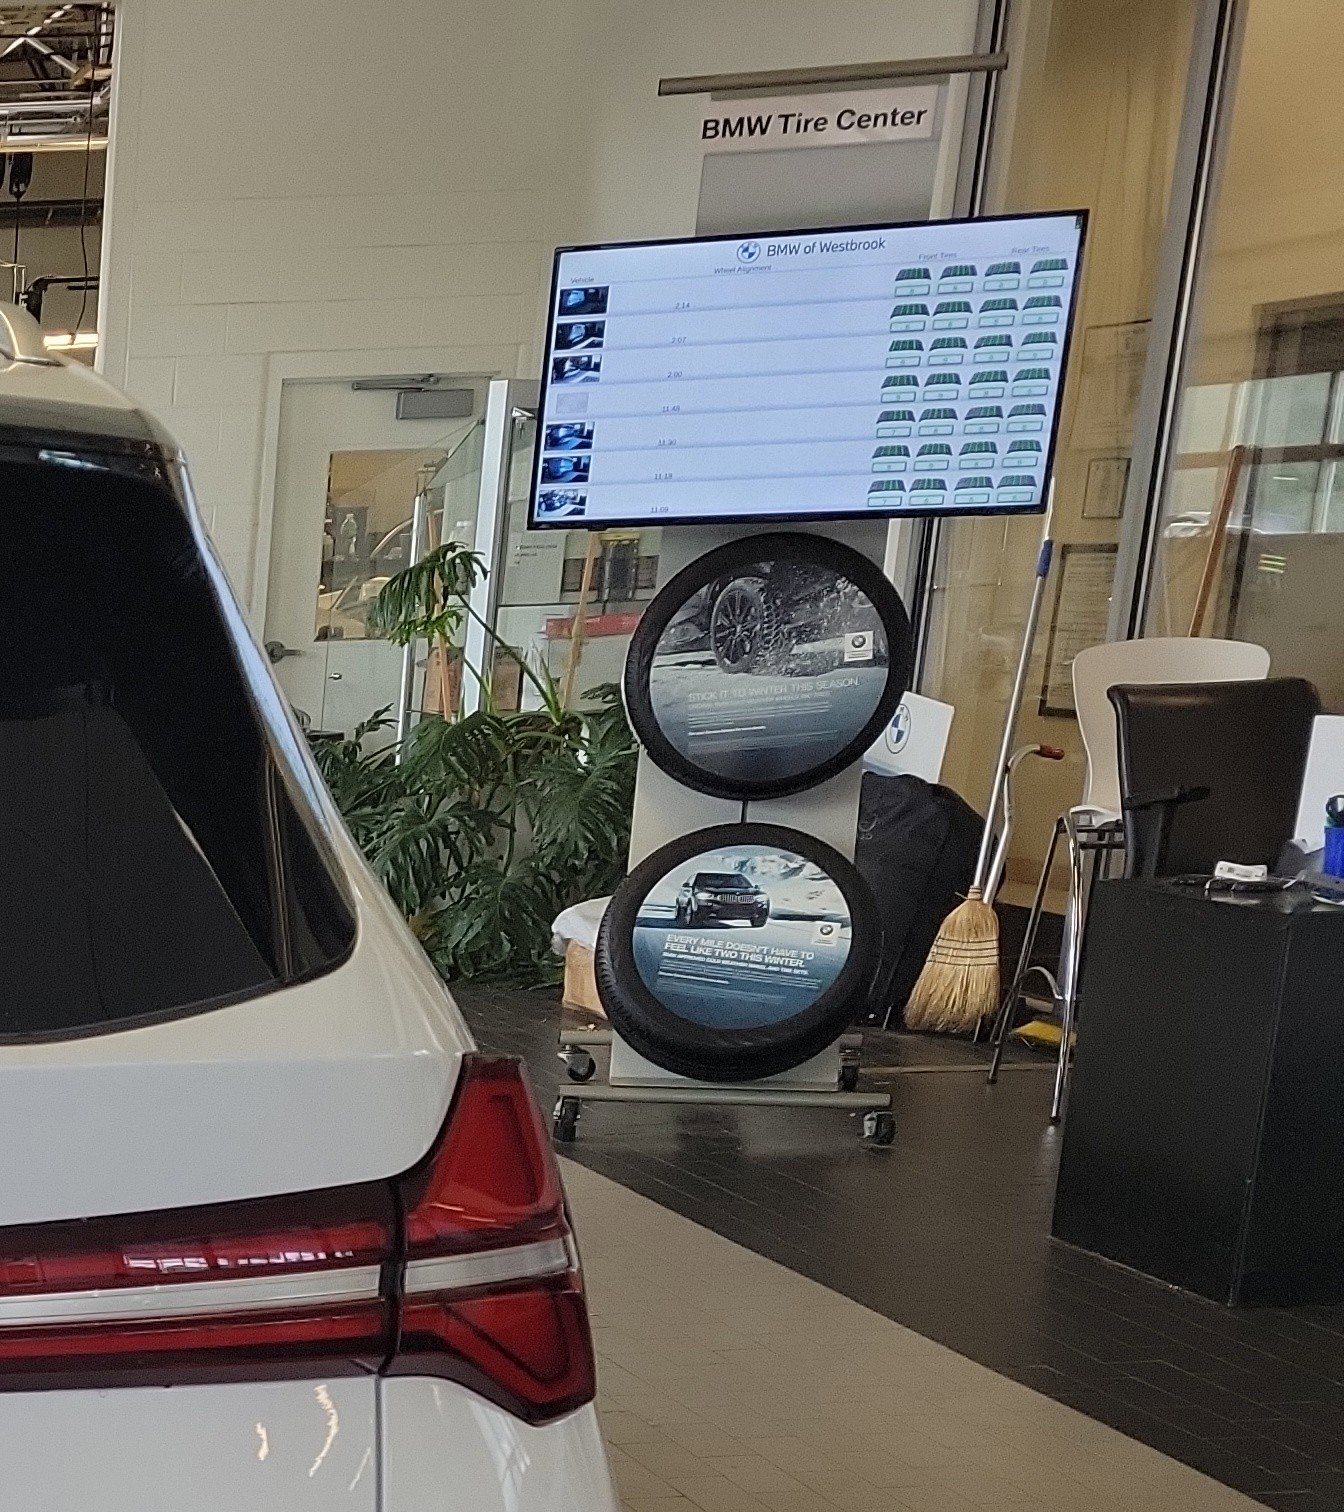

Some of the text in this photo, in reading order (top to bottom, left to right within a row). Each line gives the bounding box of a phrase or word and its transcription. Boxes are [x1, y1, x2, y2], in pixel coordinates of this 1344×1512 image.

[702, 107, 928, 139] BMW Tire Center
[767, 237, 886, 257] BMW of Westbrook
[570, 276, 595, 284] Vehicle
[664, 942, 689, 952] FEEL
[690, 945, 713, 956] LIKE
[713, 948, 738, 959] TWO
[739, 951, 763, 962] THIS
[764, 955, 805, 967] WINTER.
[667, 934, 815, 960] EVERY MILE DOESN'T HAVE TO
